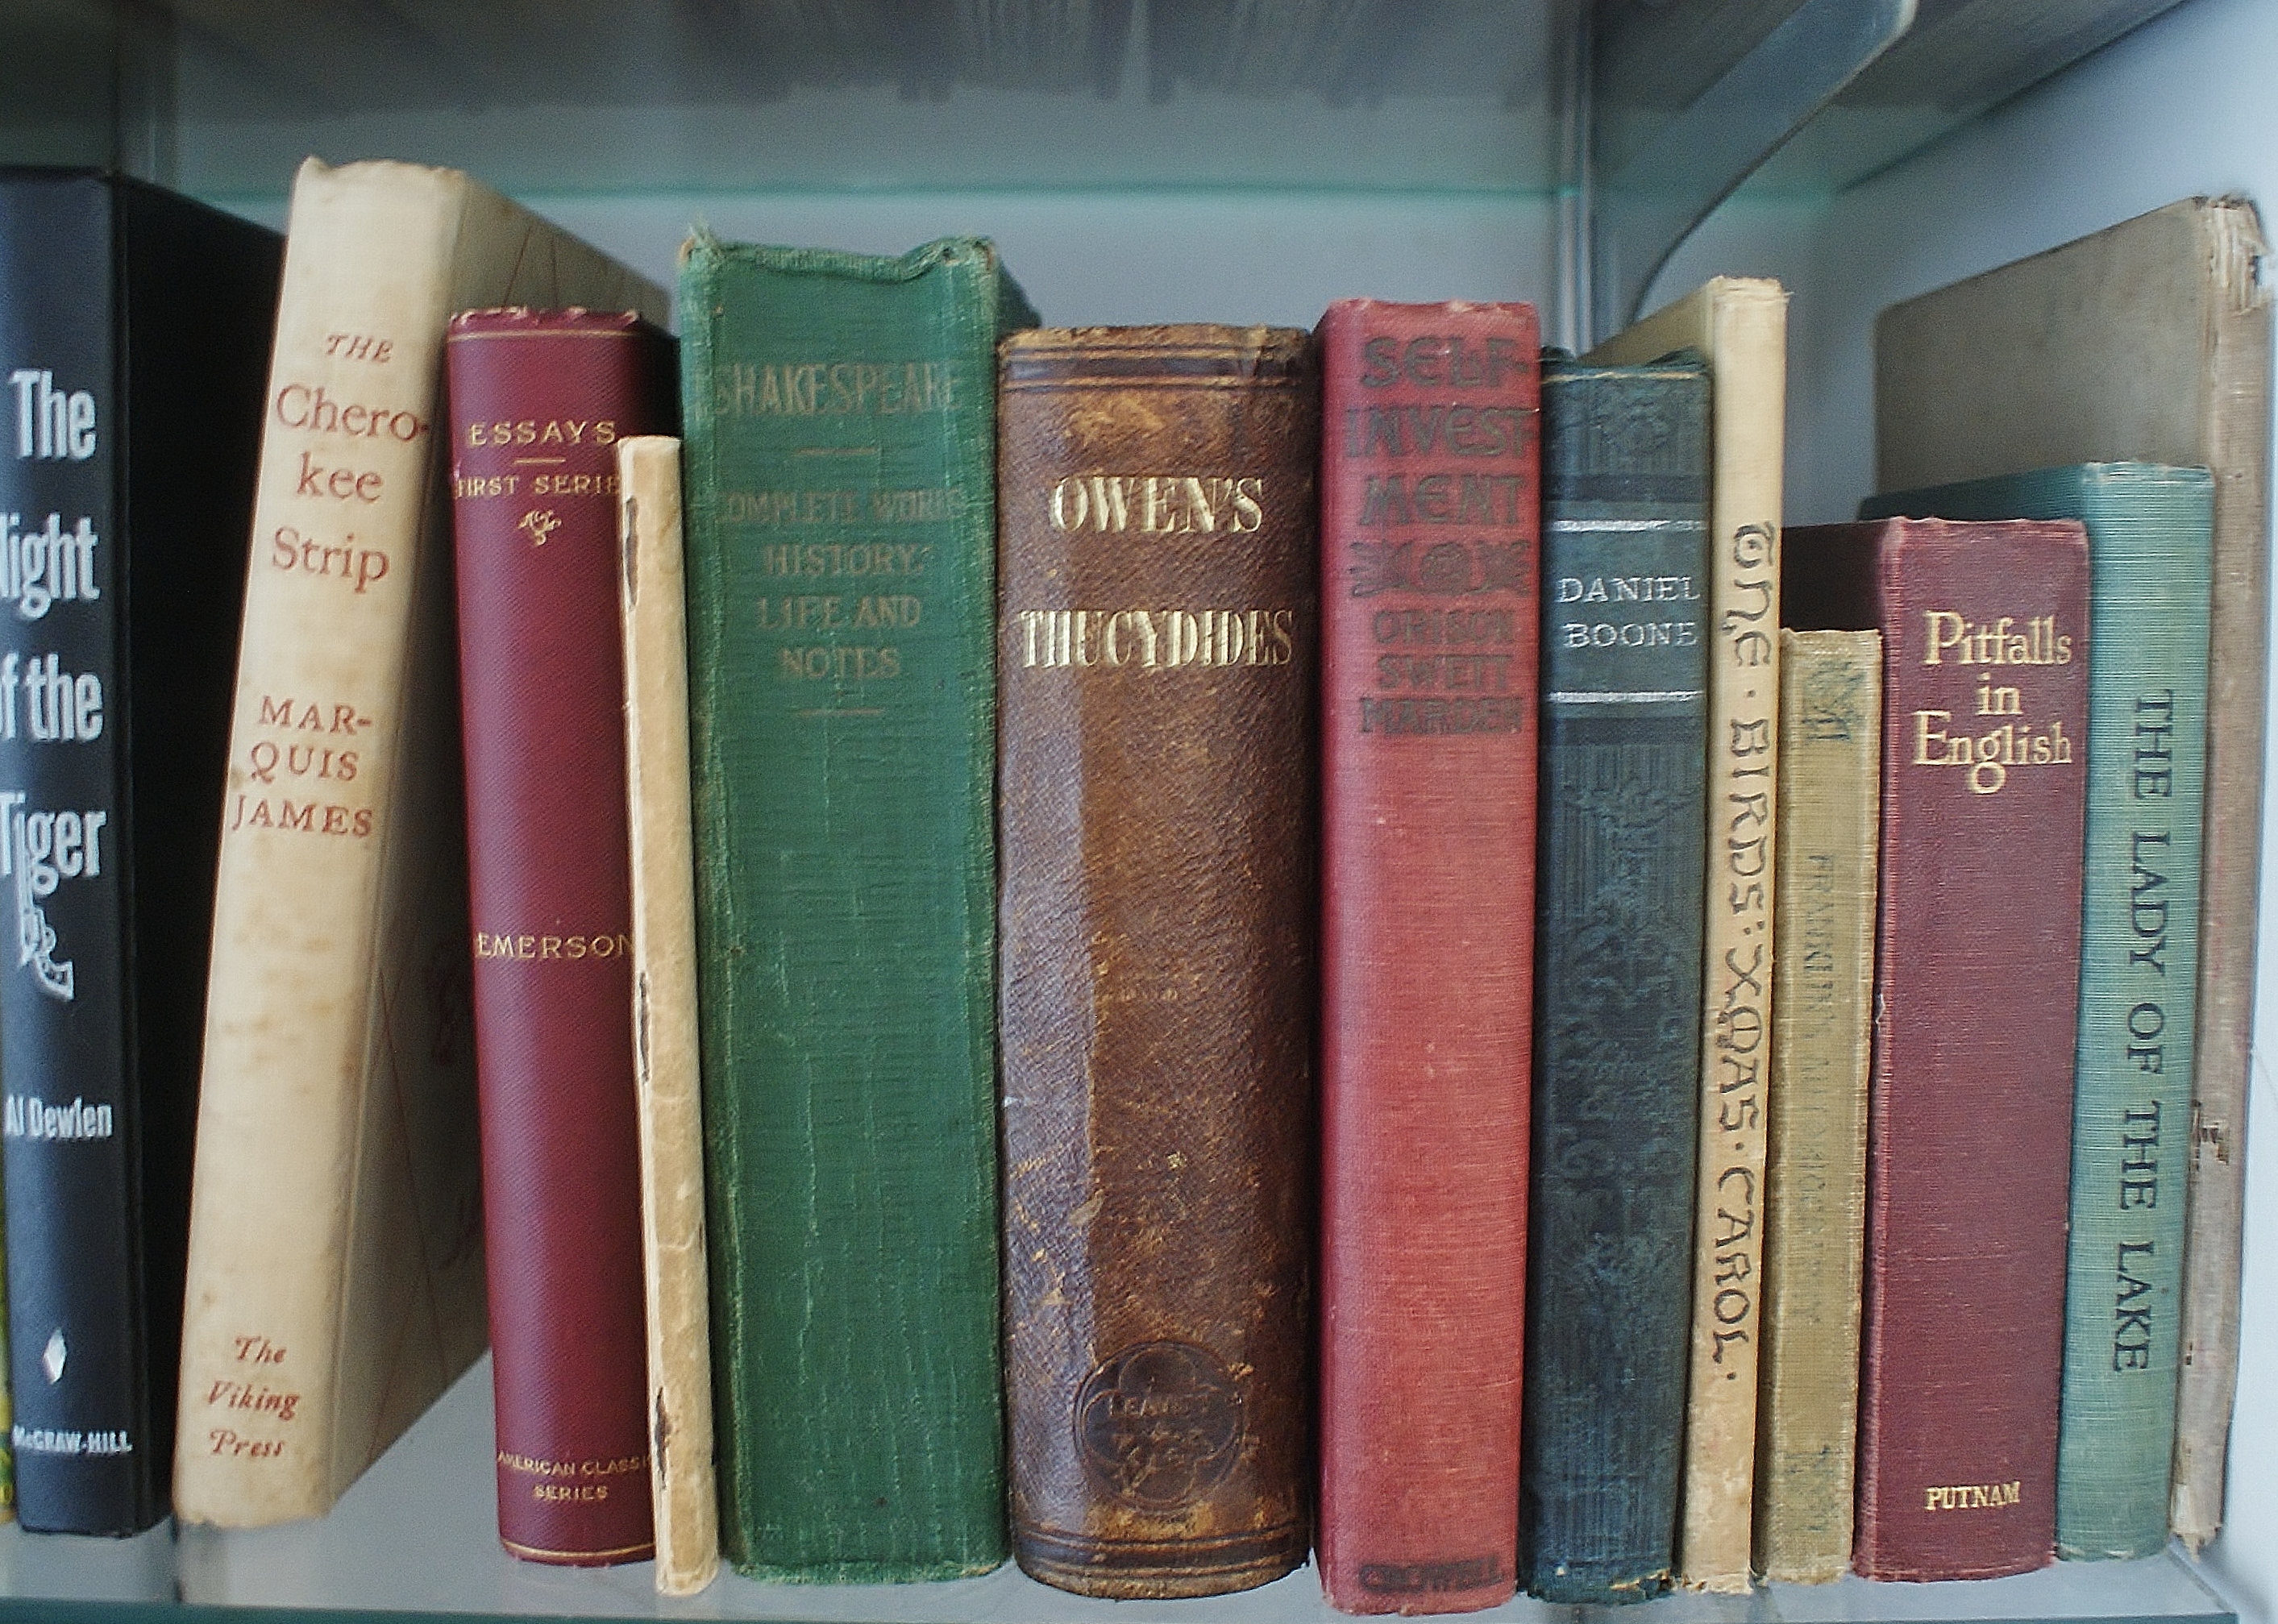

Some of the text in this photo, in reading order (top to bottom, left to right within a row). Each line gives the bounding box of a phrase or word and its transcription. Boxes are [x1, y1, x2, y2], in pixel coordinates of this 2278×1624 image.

[326, 334, 394, 364] THE
[1361, 335, 1528, 388] SELF-
[9, 370, 97, 460] The
[276, 383, 430, 443] Chero-
[469, 419, 617, 446] ESSAYS
[296, 451, 385, 502] kee
[534, 475, 621, 496] SERIE
[1048, 474, 1263, 533] OWEN'S
[1359, 474, 1524, 525] MENT
[0, 511, 101, 620] ight
[272, 526, 390, 593] Strip
[1557, 576, 1699, 602] DANIEL
[756, 594, 921, 630] LIFE AND
[1020, 608, 1293, 668] THUCYDIDES
[1563, 622, 1698, 648] BOONE
[1923, 610, 2072, 666] Pitfalls
[779, 646, 902, 680] NOTES
[0, 652, 104, 742] f the
[259, 695, 373, 735] MAR-
[1975, 671, 2022, 716] in
[250, 741, 360, 784] QUIS
[1912, 710, 2072, 795] English
[231, 794, 374, 838] JAMES
[0, 791, 108, 896] Tiger
[476, 931, 634, 960] EMERSON
[2111, 689, 2174, 1373] THE LADY OF THE LAKE
[235, 1335, 287, 1364] The
[207, 1379, 301, 1421] Viking
[210, 1428, 285, 1457] Press
[533, 1483, 608, 1502] SERIES
[1924, 1480, 2021, 1510] PUTNAM
